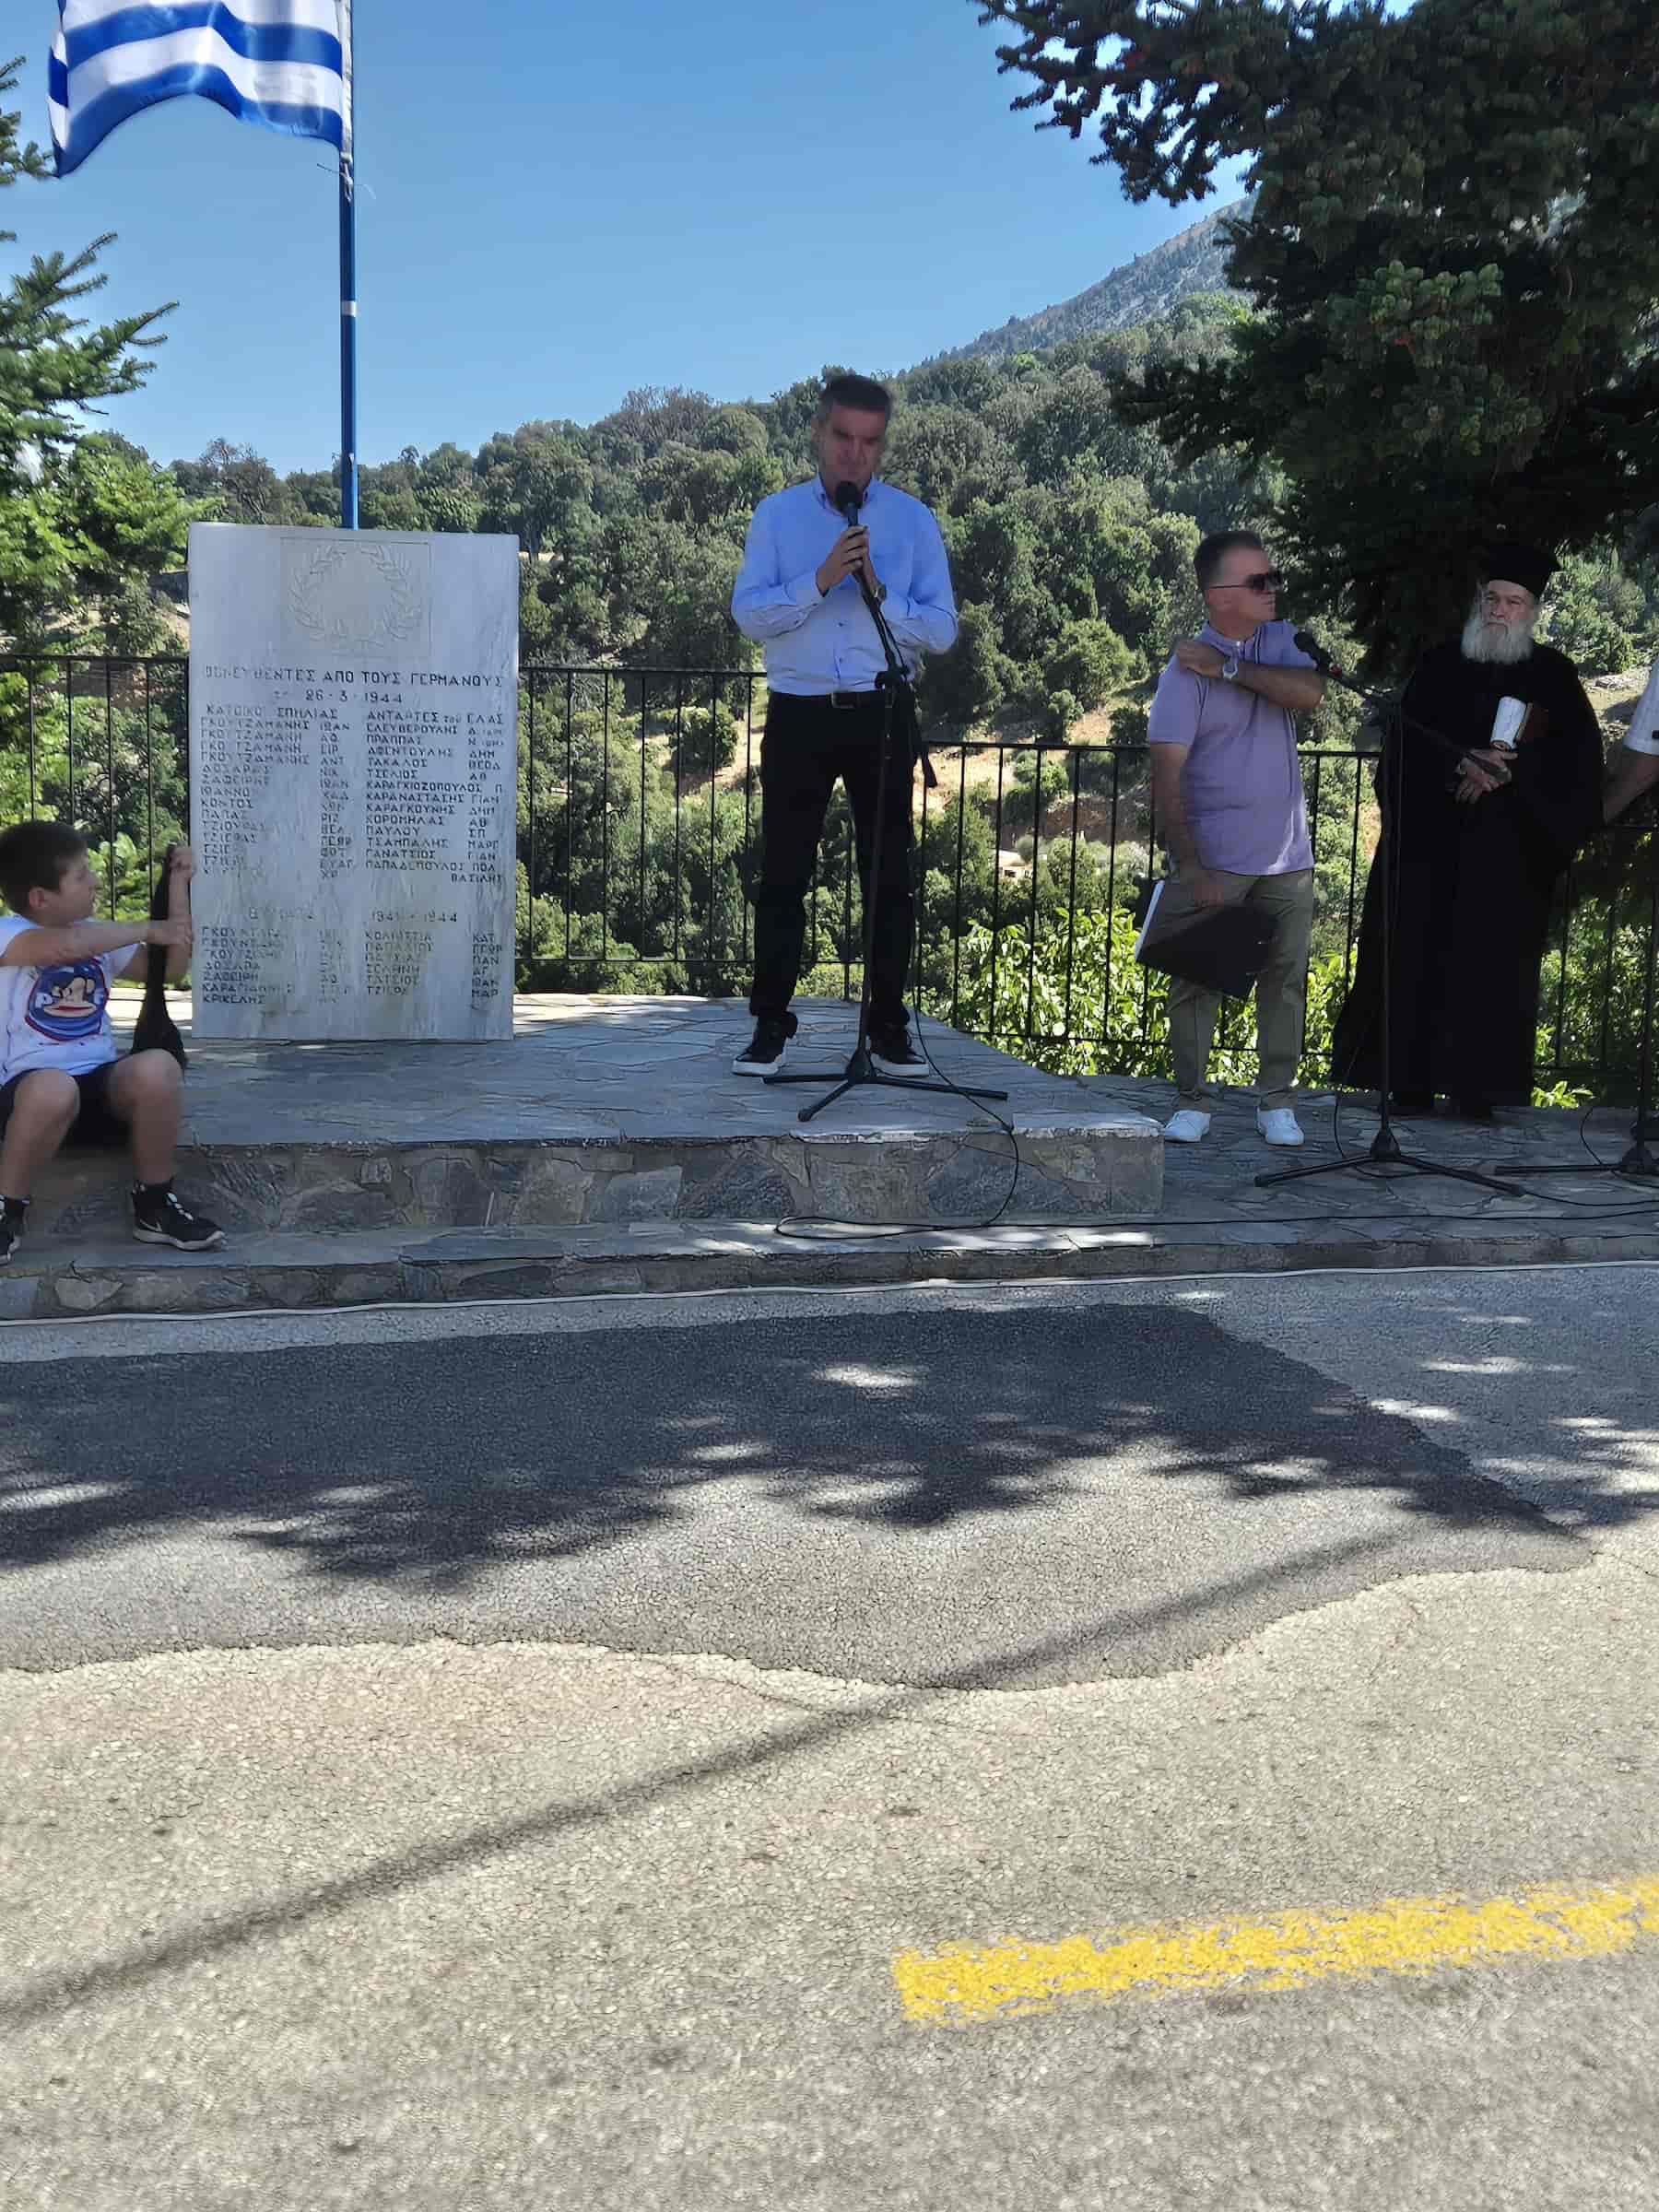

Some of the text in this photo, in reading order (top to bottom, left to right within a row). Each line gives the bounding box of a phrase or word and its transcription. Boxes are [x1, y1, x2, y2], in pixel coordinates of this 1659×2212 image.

[323, 670, 355, 684] ΑΠΟ
[361, 670, 401, 685] ΤΟΥΣ
[410, 672, 502, 688] ΓΕΡΜΑΝΟΥΣ
